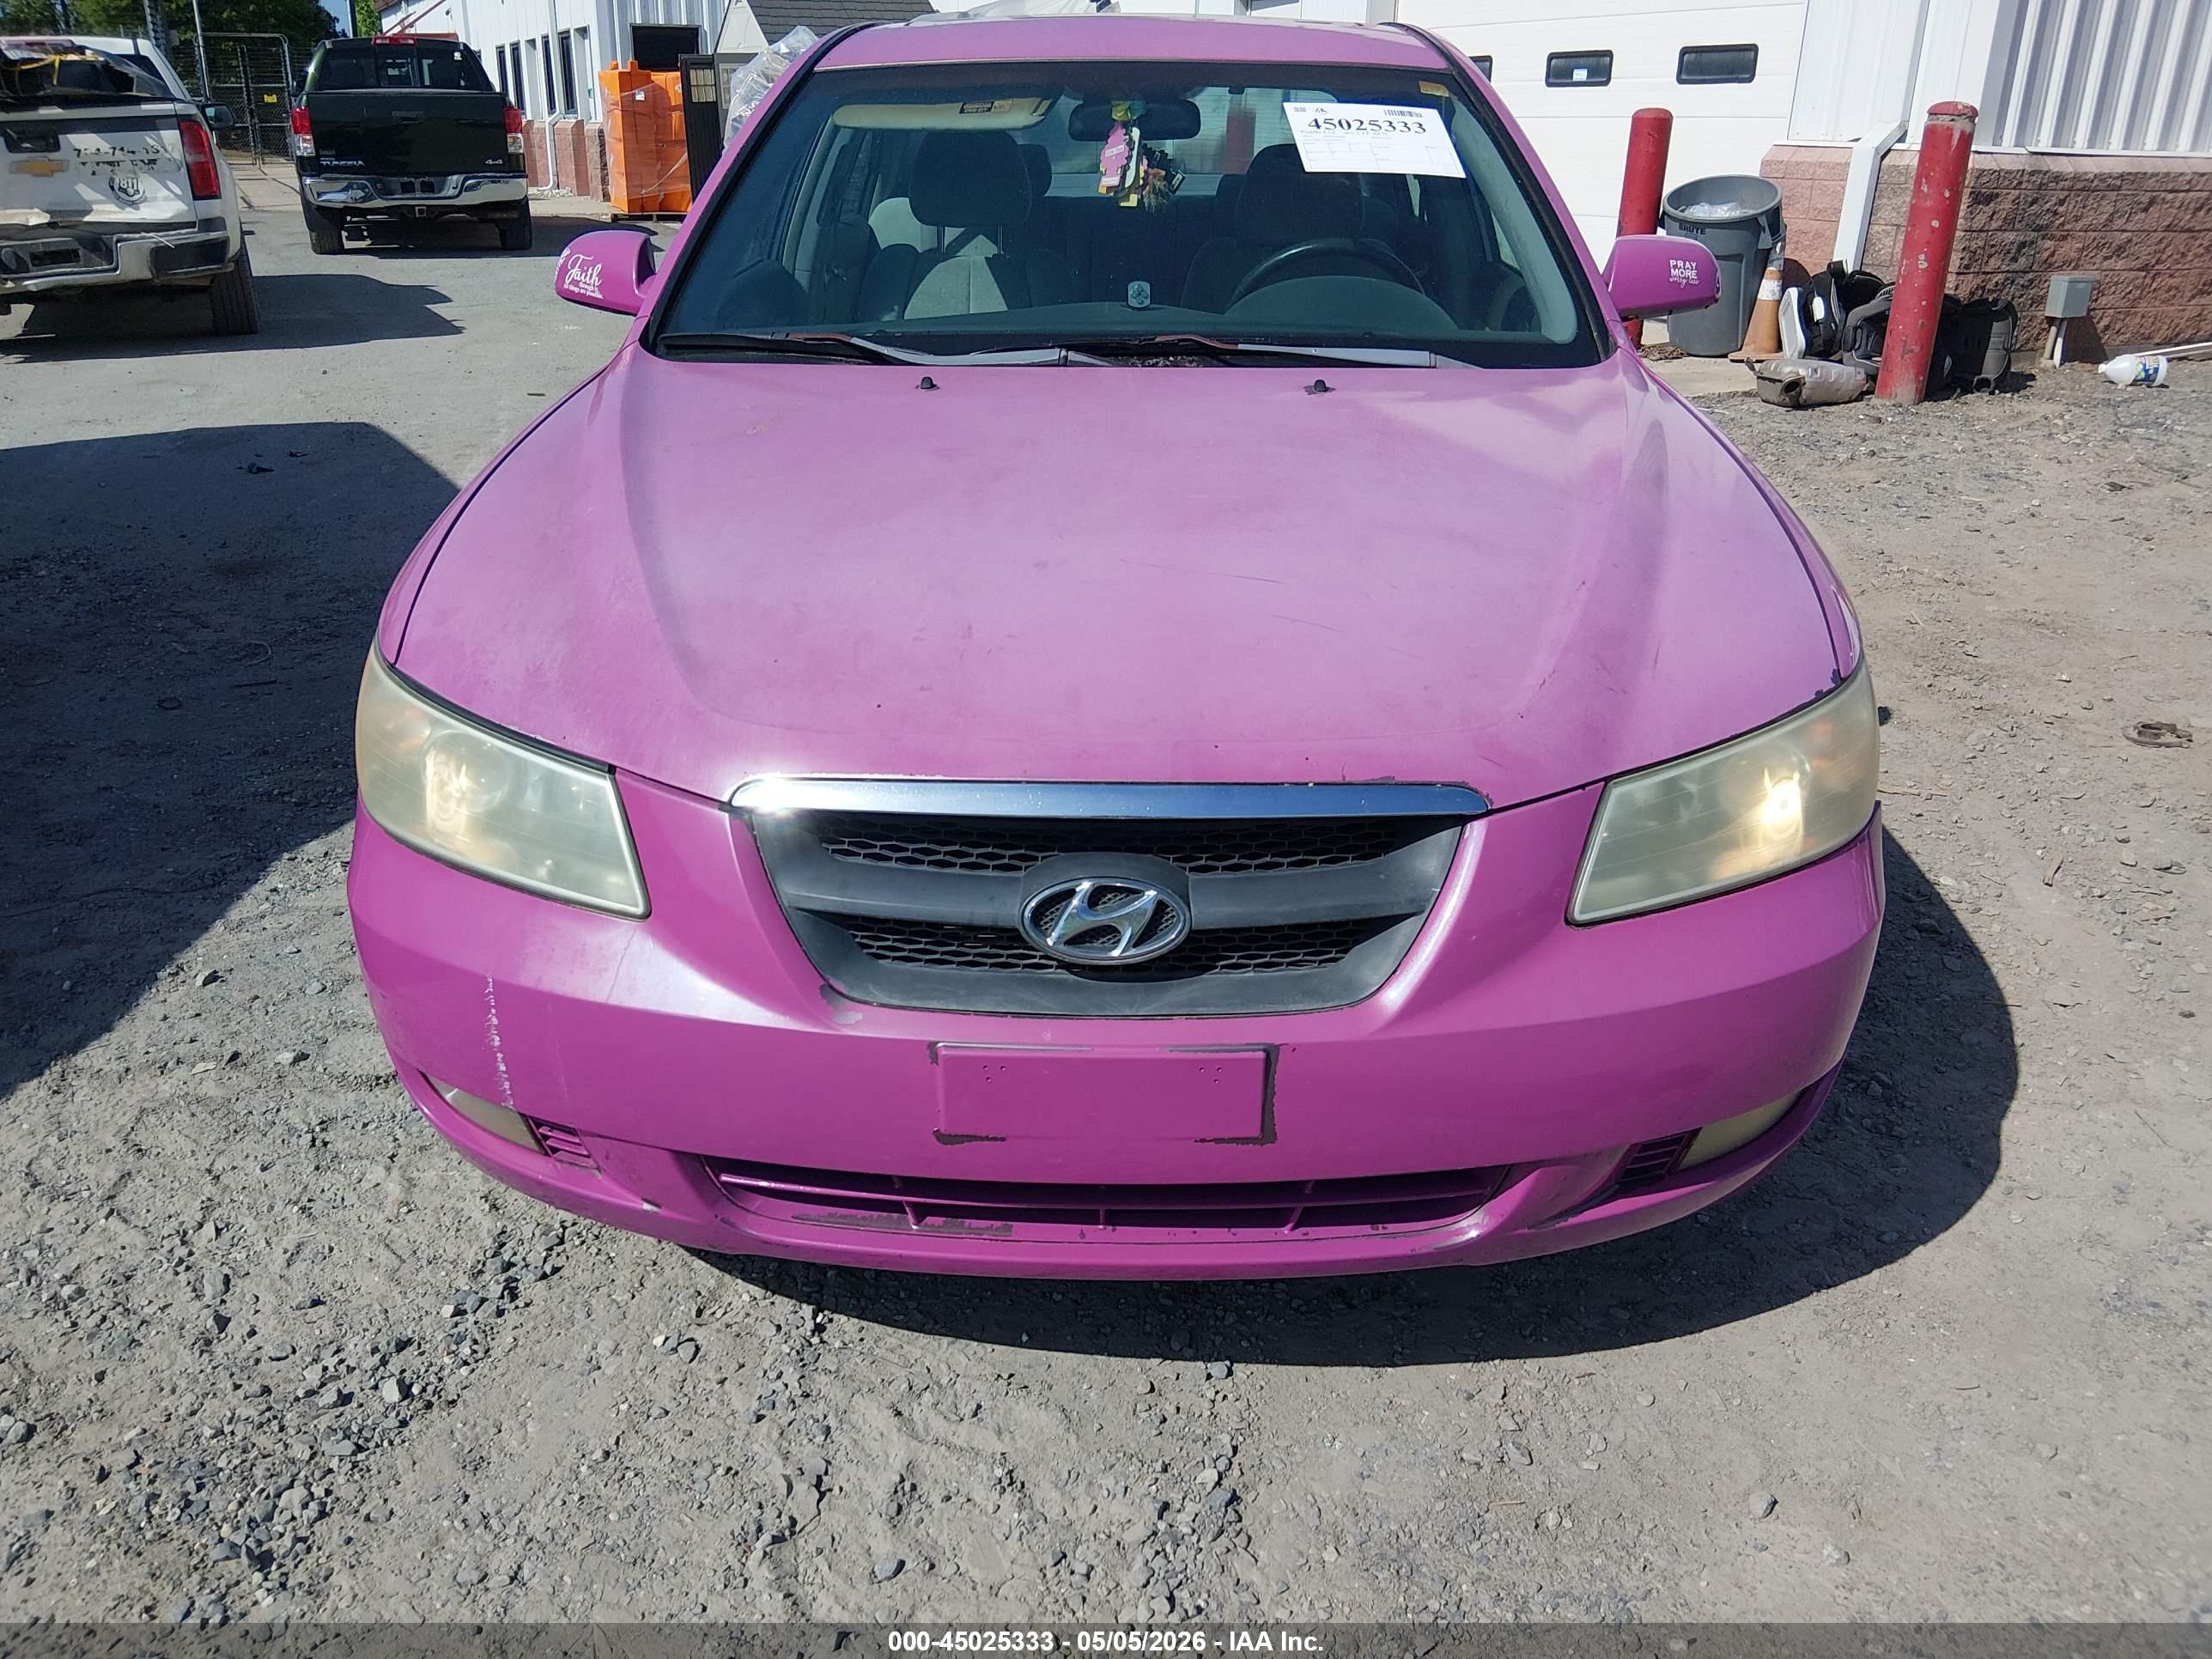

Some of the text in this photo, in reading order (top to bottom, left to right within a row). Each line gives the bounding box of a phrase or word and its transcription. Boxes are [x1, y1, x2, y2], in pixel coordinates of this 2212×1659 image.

[1308, 118, 1426, 134] 45025333
[119, 177, 138, 190] 811
[1679, 222, 1706, 235] BRUTE
[565, 254, 603, 286] Faith
[1669, 259, 1697, 270] PRAY
[1670, 267, 1698, 279] MORE
